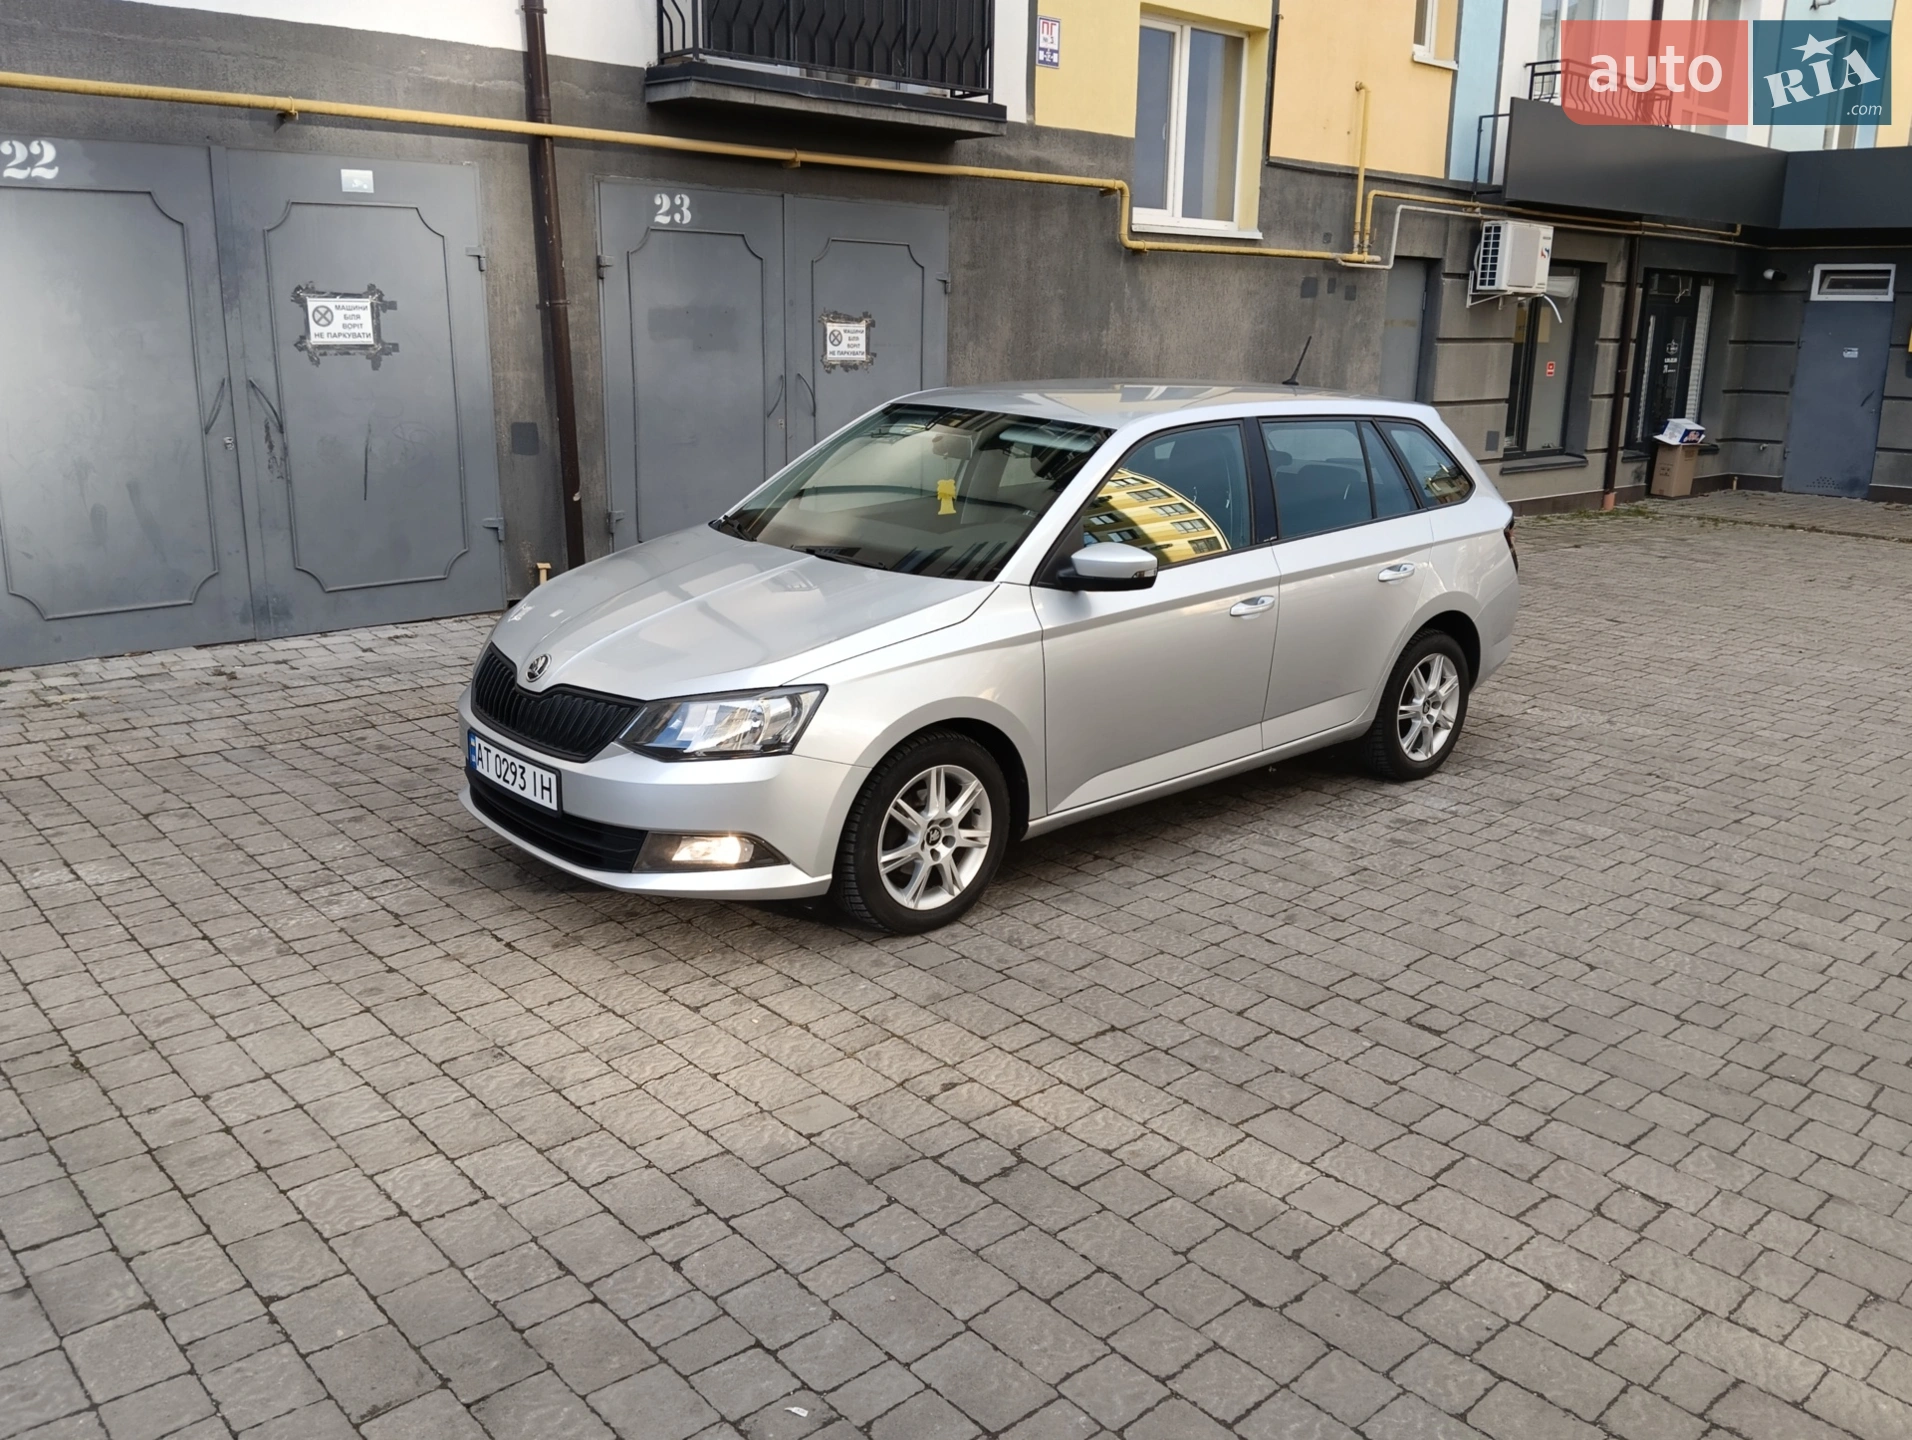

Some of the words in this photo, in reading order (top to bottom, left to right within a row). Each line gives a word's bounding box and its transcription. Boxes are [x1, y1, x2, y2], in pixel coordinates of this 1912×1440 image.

[1042, 21, 1057, 36] ПГ
[0, 140, 59, 179] 22
[654, 193, 692, 225] 23
[477, 743, 492, 773] AT
[495, 753, 526, 791] 0293
[533, 771, 552, 804] IH
